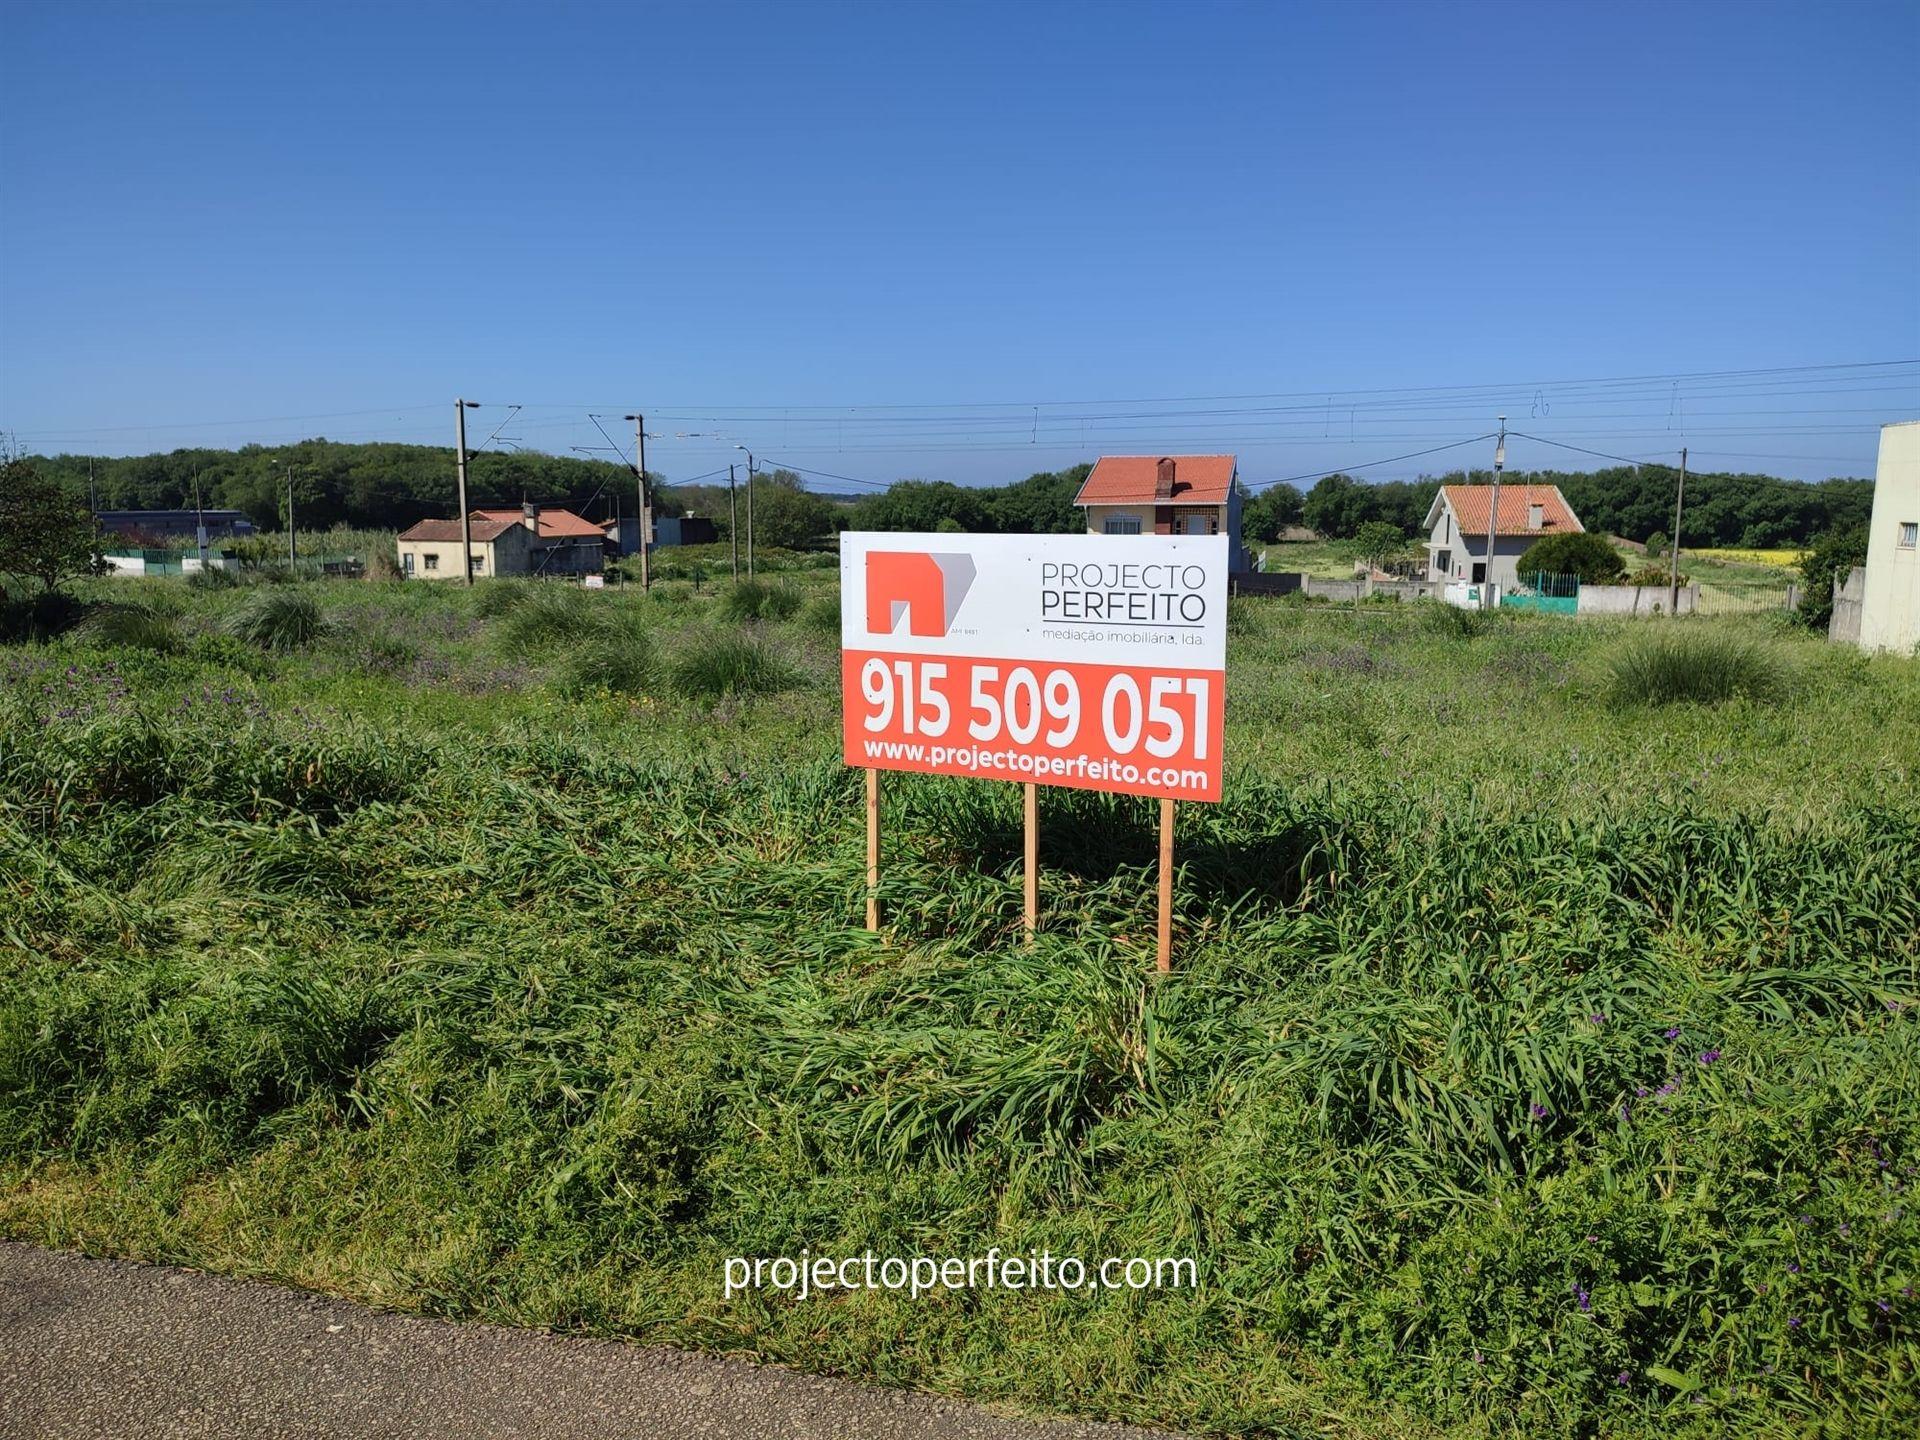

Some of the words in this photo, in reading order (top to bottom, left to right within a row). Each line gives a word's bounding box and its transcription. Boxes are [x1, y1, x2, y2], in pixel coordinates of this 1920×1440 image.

[1042, 563, 1206, 590] PROJECTO
[1042, 590, 1206, 622] PERFEITO
[1042, 628, 1104, 642] mediação
[1182, 633, 1206, 646] lda.
[861, 657, 951, 738] 915
[968, 665, 1081, 748] 509
[1101, 672, 1210, 760] 051
[863, 739, 1208, 789] www.projectoperfeito.com
